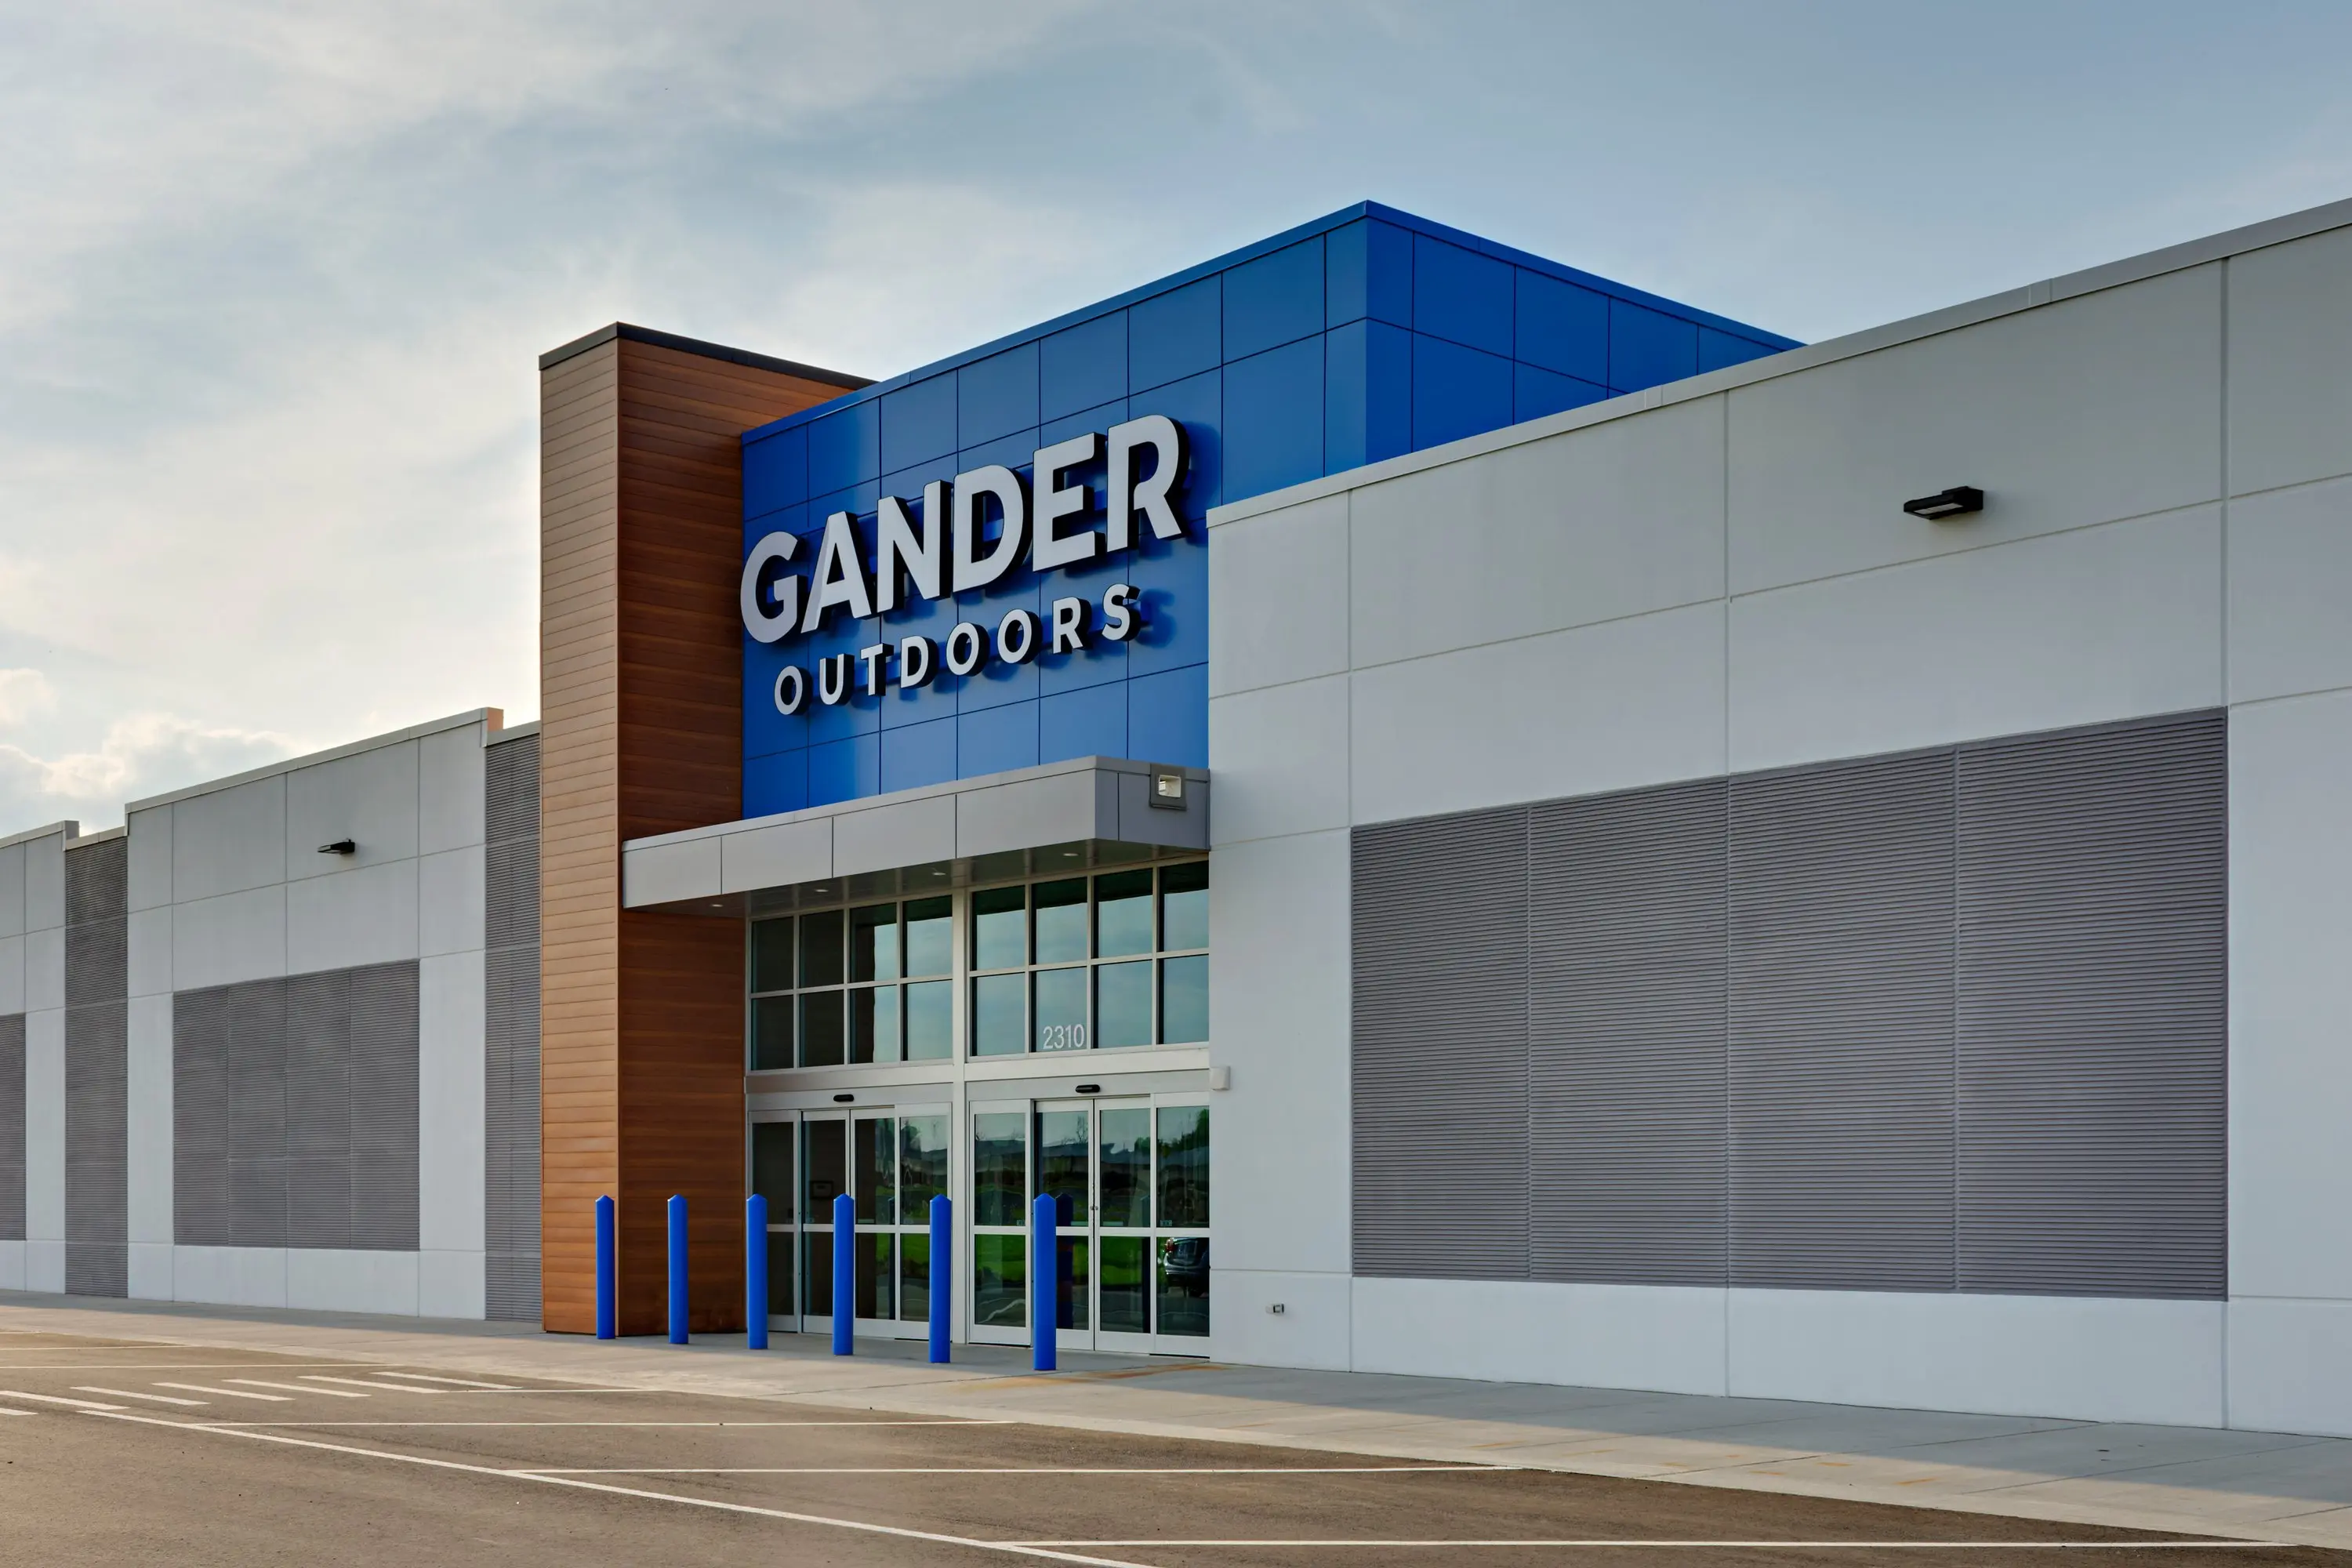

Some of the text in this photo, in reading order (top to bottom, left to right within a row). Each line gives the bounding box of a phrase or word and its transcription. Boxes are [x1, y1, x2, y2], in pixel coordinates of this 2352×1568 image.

[740, 414, 1182, 644] GANDER
[774, 583, 1142, 716] OUTDOORS
[1043, 1023, 1085, 1049] 2310
